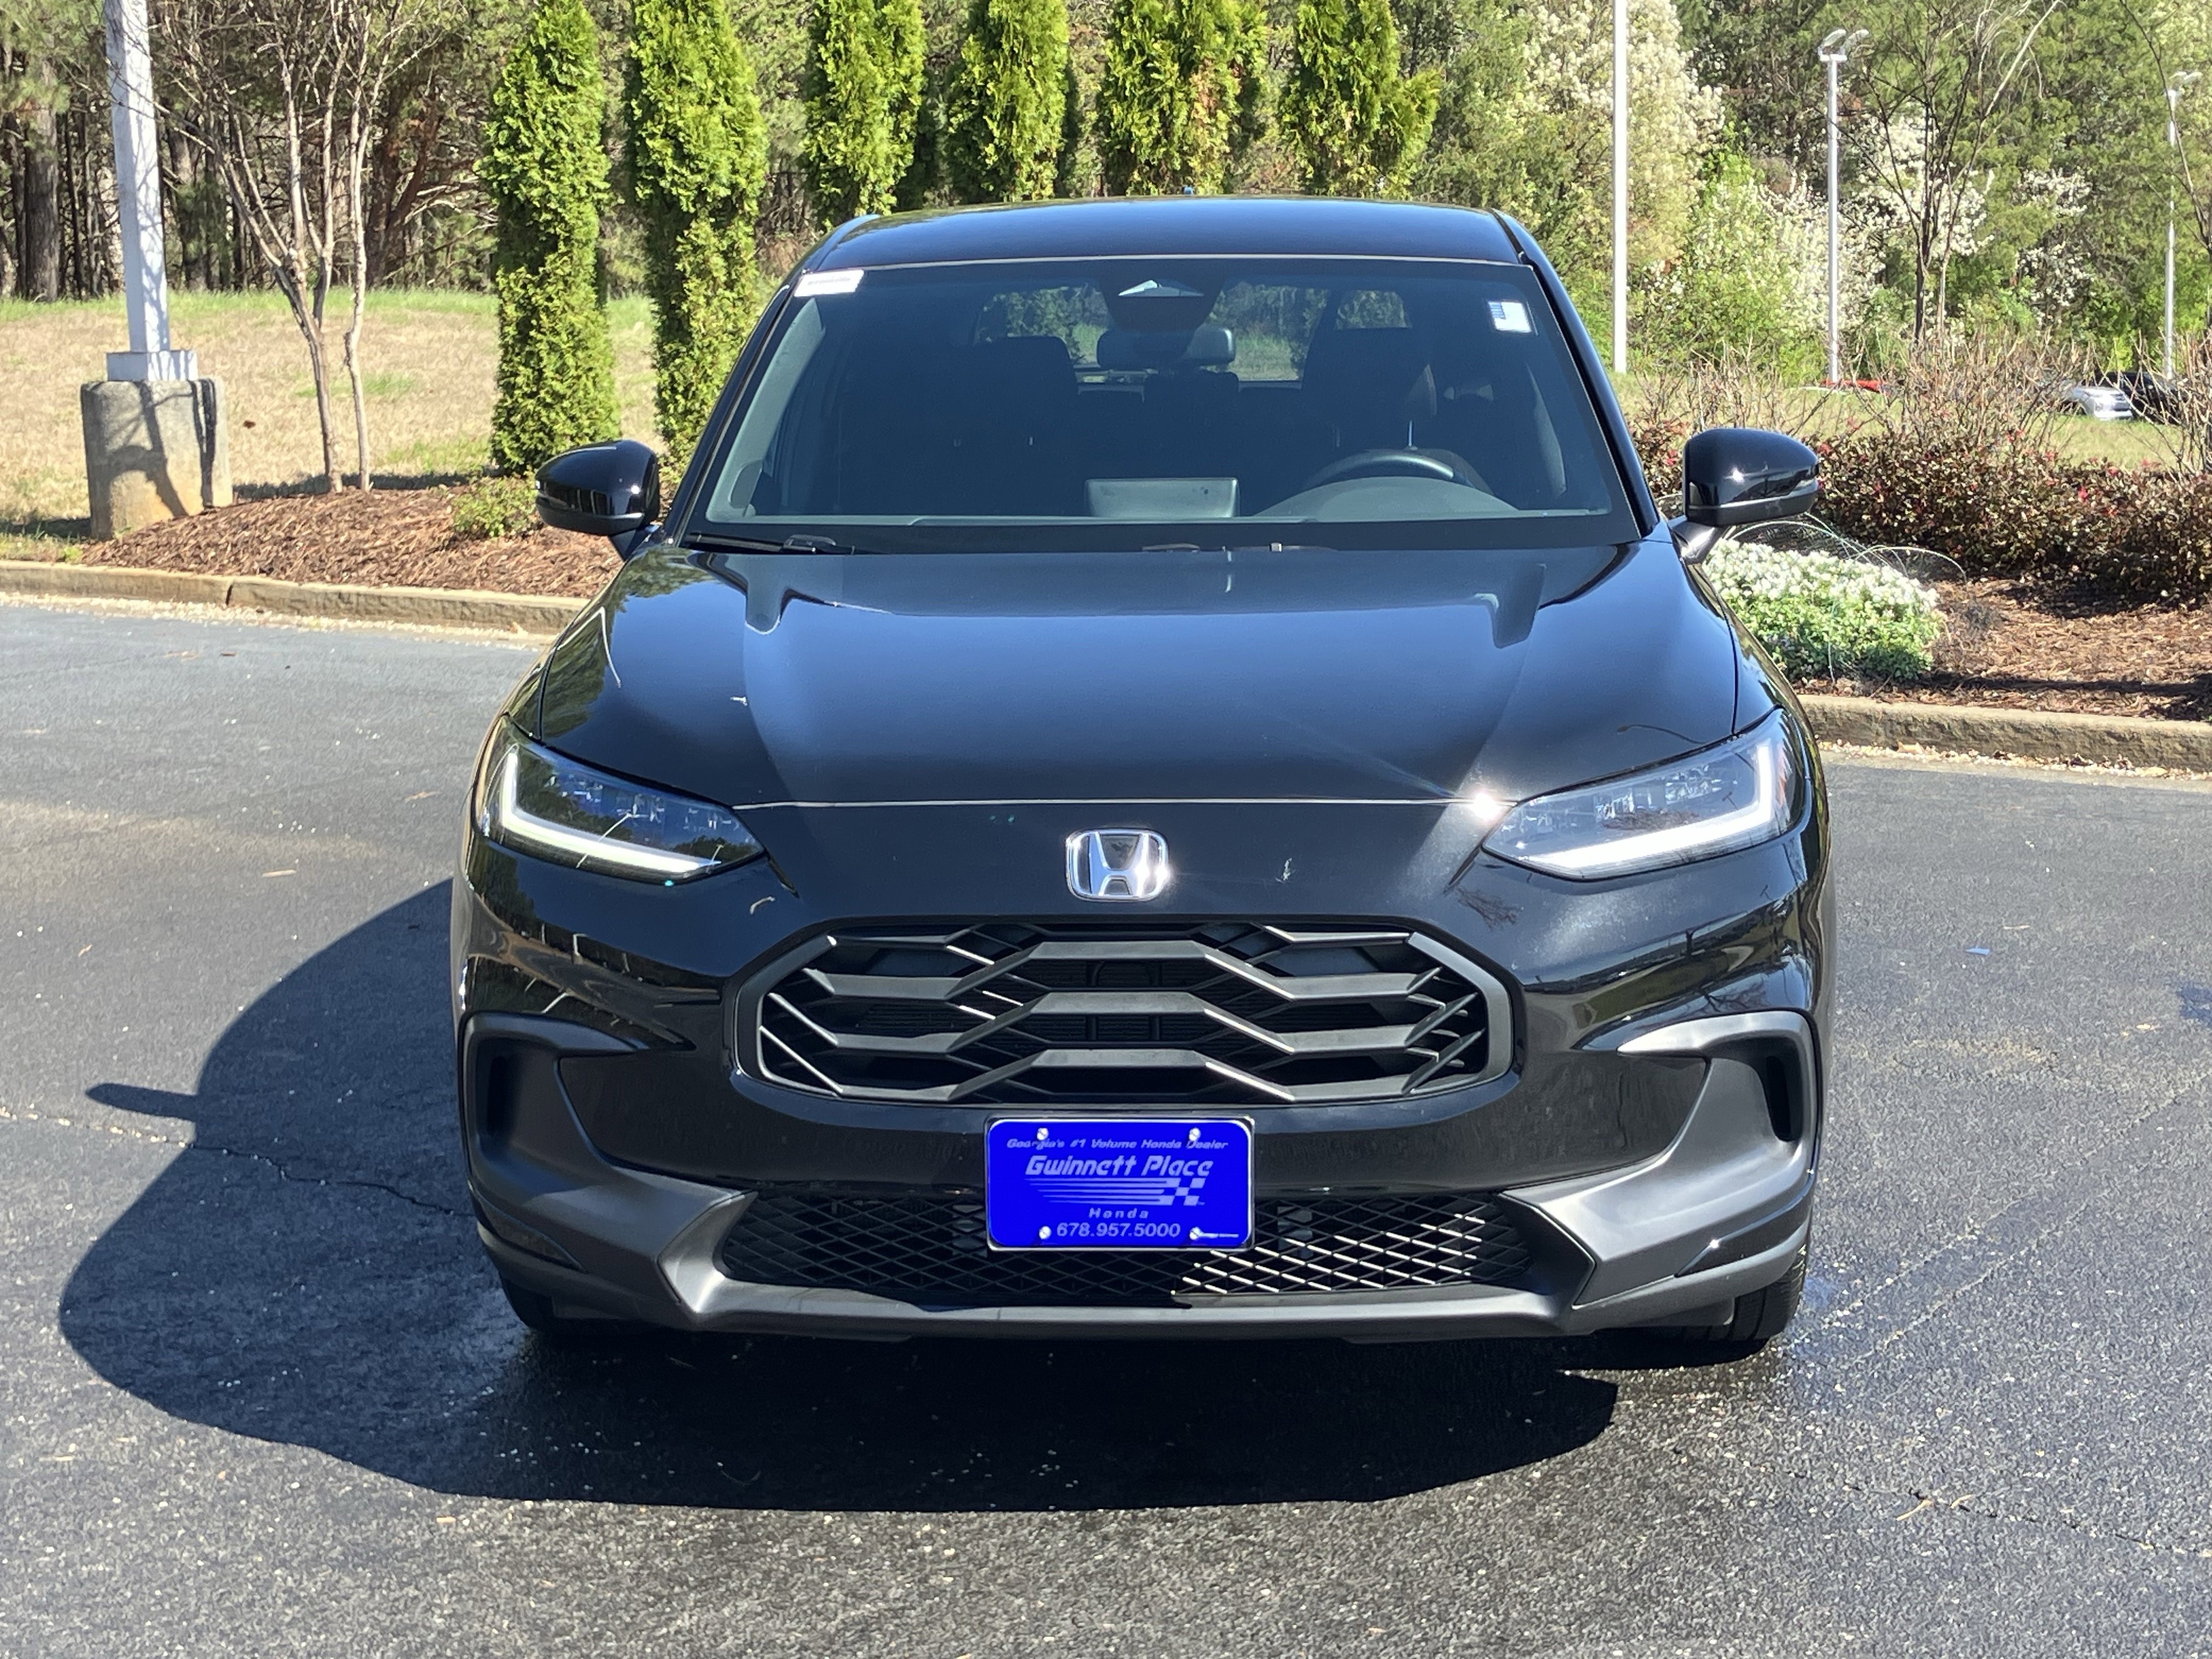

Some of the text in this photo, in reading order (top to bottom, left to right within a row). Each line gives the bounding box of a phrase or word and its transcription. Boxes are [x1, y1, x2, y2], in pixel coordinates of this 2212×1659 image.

[1007, 1138, 1228, 1150] Georgia's #1 Volume Honda Dealer
[1025, 1155, 1214, 1176] Gwinnett Place
[1088, 1207, 1149, 1219] Honda
[1057, 1222, 1181, 1237] 678.957.5000
